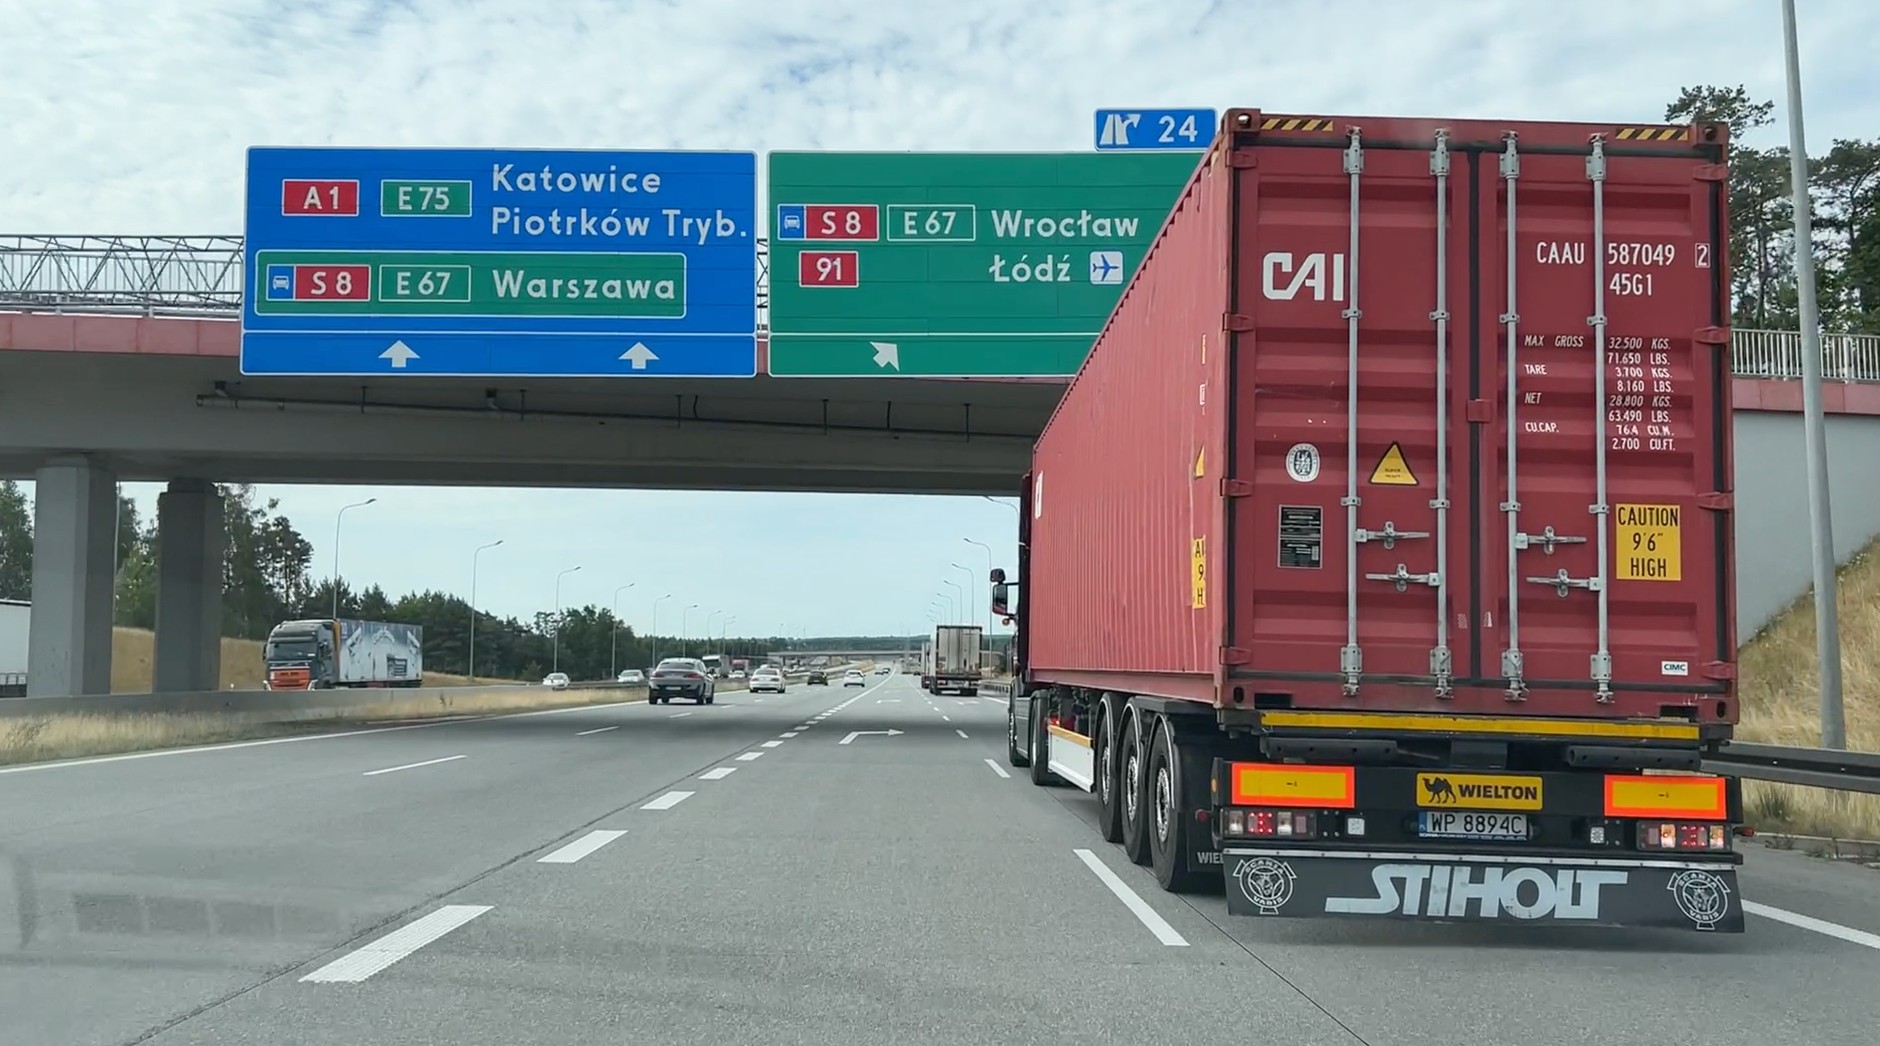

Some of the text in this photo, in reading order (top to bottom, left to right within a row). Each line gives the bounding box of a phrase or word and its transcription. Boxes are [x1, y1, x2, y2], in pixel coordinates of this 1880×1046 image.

[1158, 115, 1199, 143] 24
[491, 164, 662, 194] Katowice
[491, 206, 748, 246] Piotrków Tryb.
[991, 209, 1140, 238] Wrocław
[1536, 241, 1709, 267] CAAU 587049 2
[815, 257, 844, 282] 91
[988, 252, 1072, 283] Łódź
[1262, 252, 1345, 301] CAI
[491, 269, 676, 300] Warszawa
[1609, 273, 1653, 296] 45G1
[1524, 334, 1545, 347] MAX
[1554, 335, 1585, 348] GROSS
[1650, 337, 1672, 350] KGS.
[1607, 352, 1671, 366] 71.650 LBS.
[1524, 363, 1674, 379] TARE 3.700 KGS.
[1616, 379, 1675, 394] 8.160 LBS.
[1524, 392, 1542, 405] NET
[1651, 395, 1673, 408] KGS.
[1608, 409, 1672, 423] 63.490 LBS.
[1611, 437, 1641, 451] 2.700
[1617, 506, 1679, 527] CAUTION
[1630, 556, 1667, 578] HIGH
[1663, 661, 1686, 673] CIMC
[1458, 781, 1538, 802] WIELTON
[1431, 812, 1523, 834] WP 8894C
[1325, 863, 1629, 920] STIHOLT
